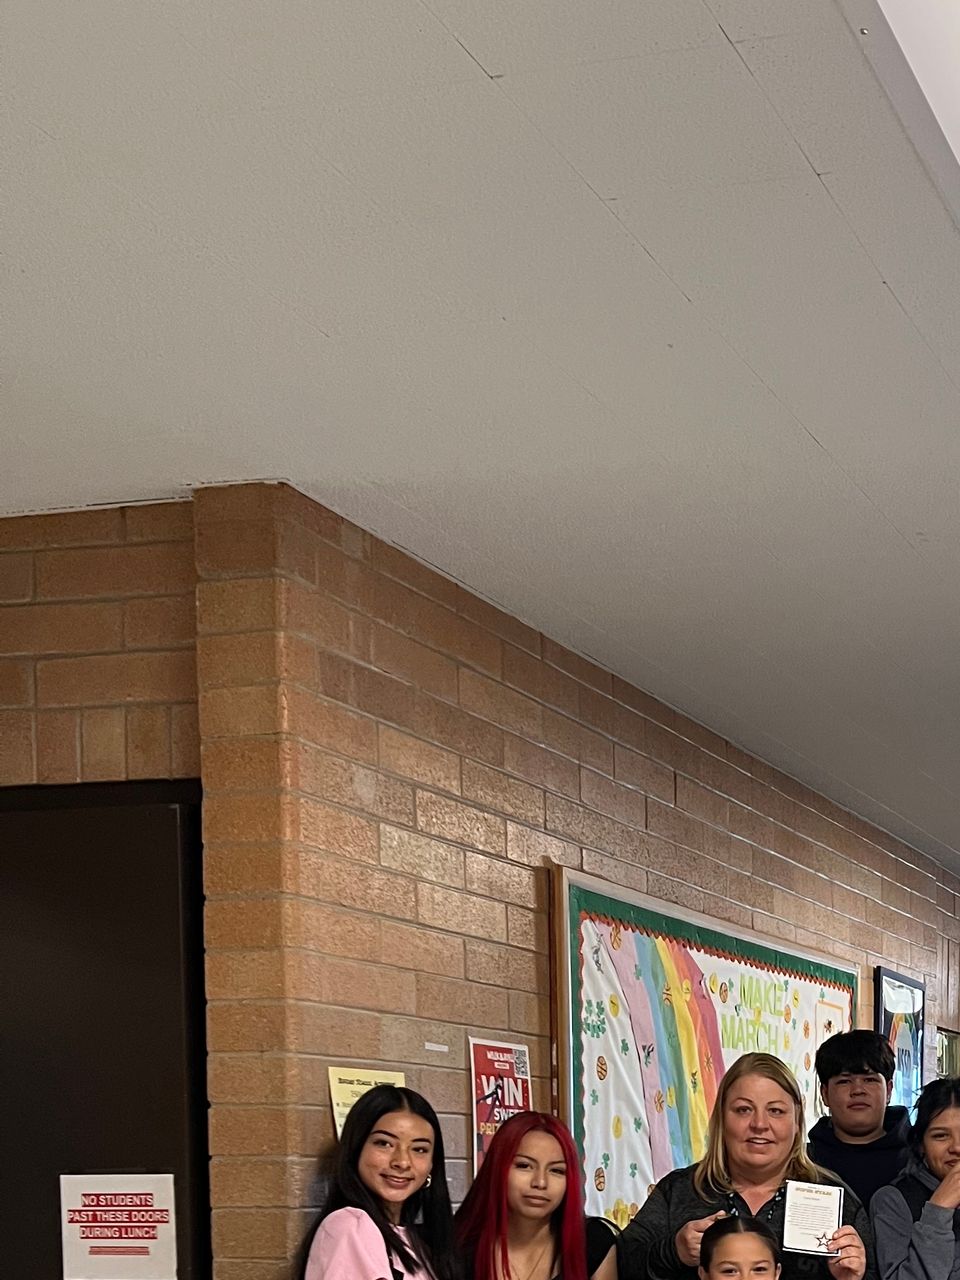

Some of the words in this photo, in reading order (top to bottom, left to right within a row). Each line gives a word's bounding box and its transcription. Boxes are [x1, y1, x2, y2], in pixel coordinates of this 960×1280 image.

[740, 973, 784, 1016] MAKE
[721, 1013, 779, 1054] MARCH
[480, 1074, 524, 1107] WIN
[81, 1194, 97, 1206] NO
[98, 1194, 154, 1206] STUDENTS
[68, 1211, 95, 1222] PAST
[95, 1211, 130, 1222] THESE
[131, 1211, 169, 1222] DOORS
[80, 1227, 120, 1238] DURING
[121, 1227, 157, 1238] LUNCH
